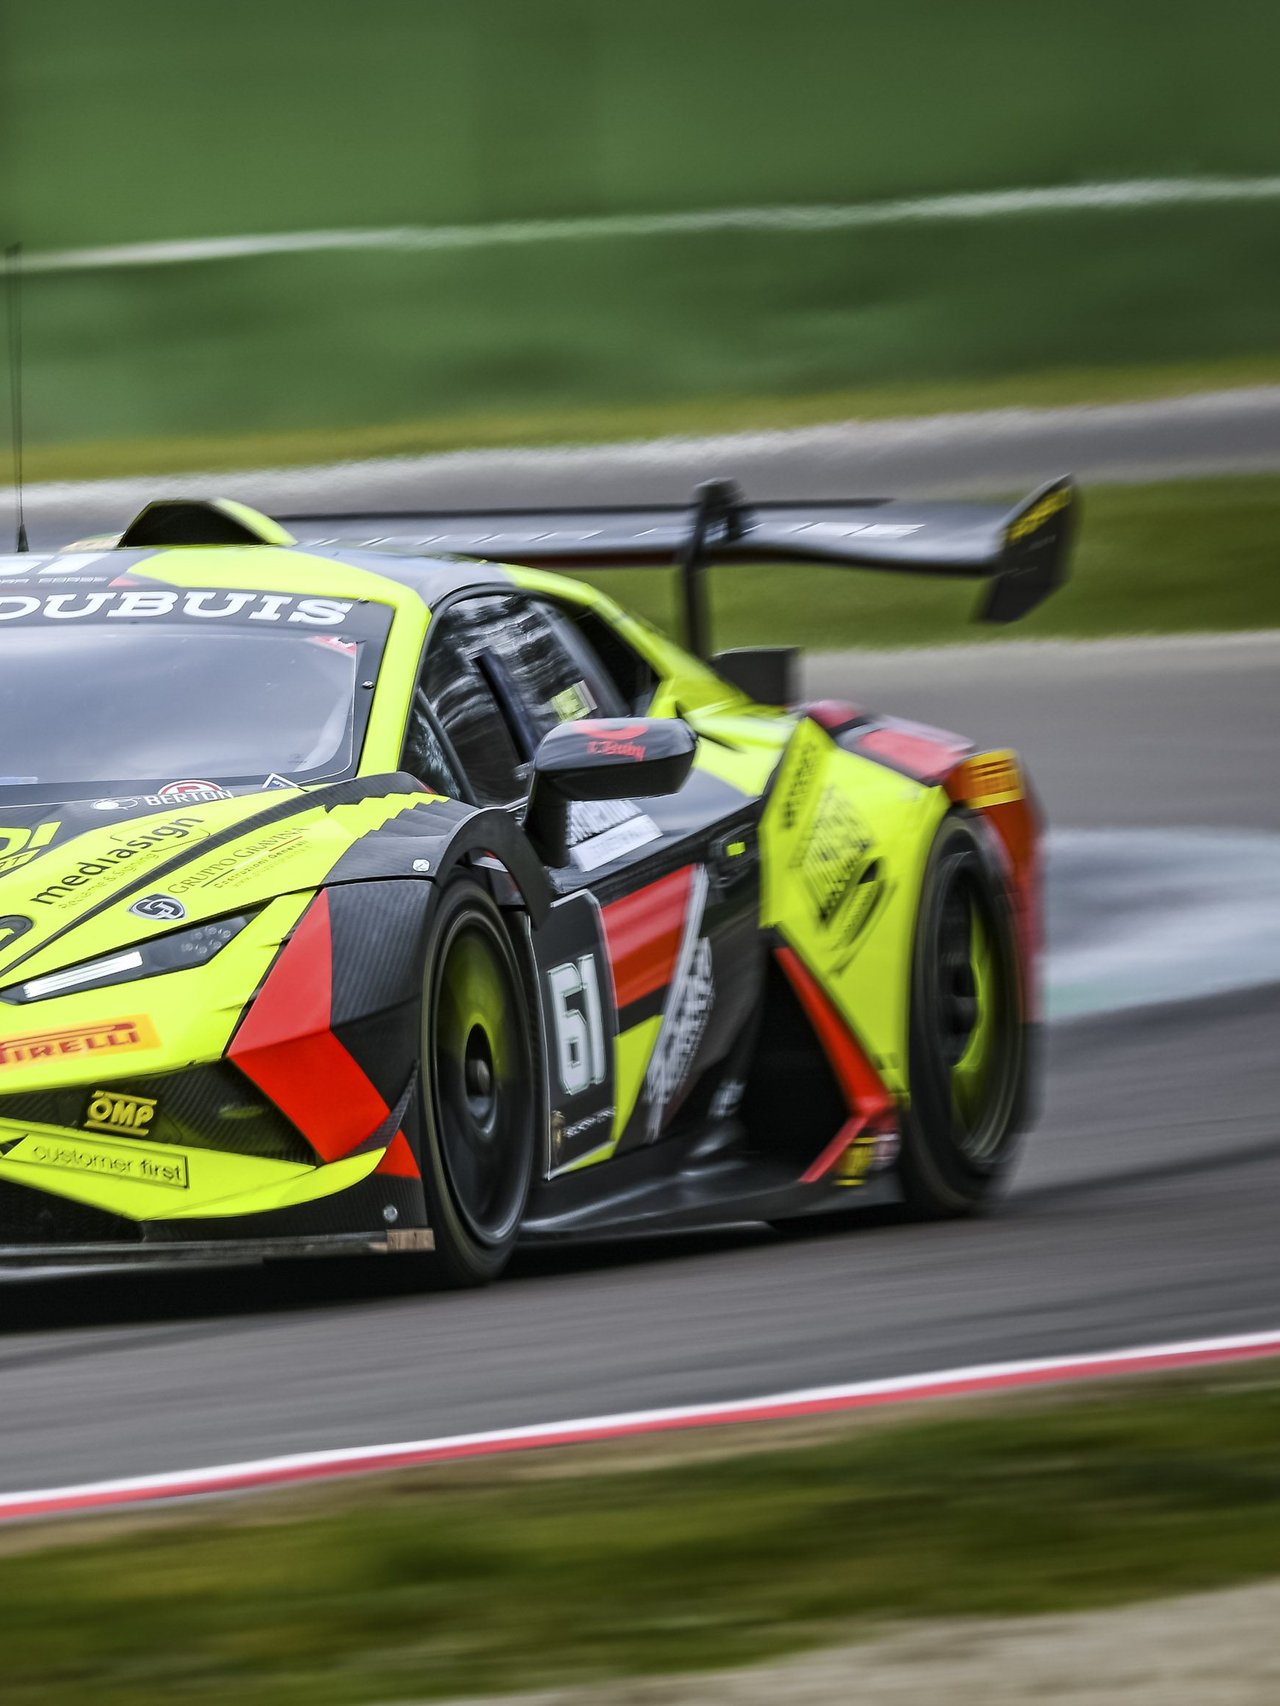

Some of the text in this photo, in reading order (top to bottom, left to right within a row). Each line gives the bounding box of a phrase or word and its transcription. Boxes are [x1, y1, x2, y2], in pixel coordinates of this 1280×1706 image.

[143, 788, 235, 807] BERTON
[29, 816, 205, 905] mediasign
[167, 857, 238, 894] GRUPPO
[232, 827, 311, 858] GRAVINA
[546, 953, 607, 1096] 61
[86, 1096, 155, 1129] OMP
[32, 1145, 182, 1182] customer first
